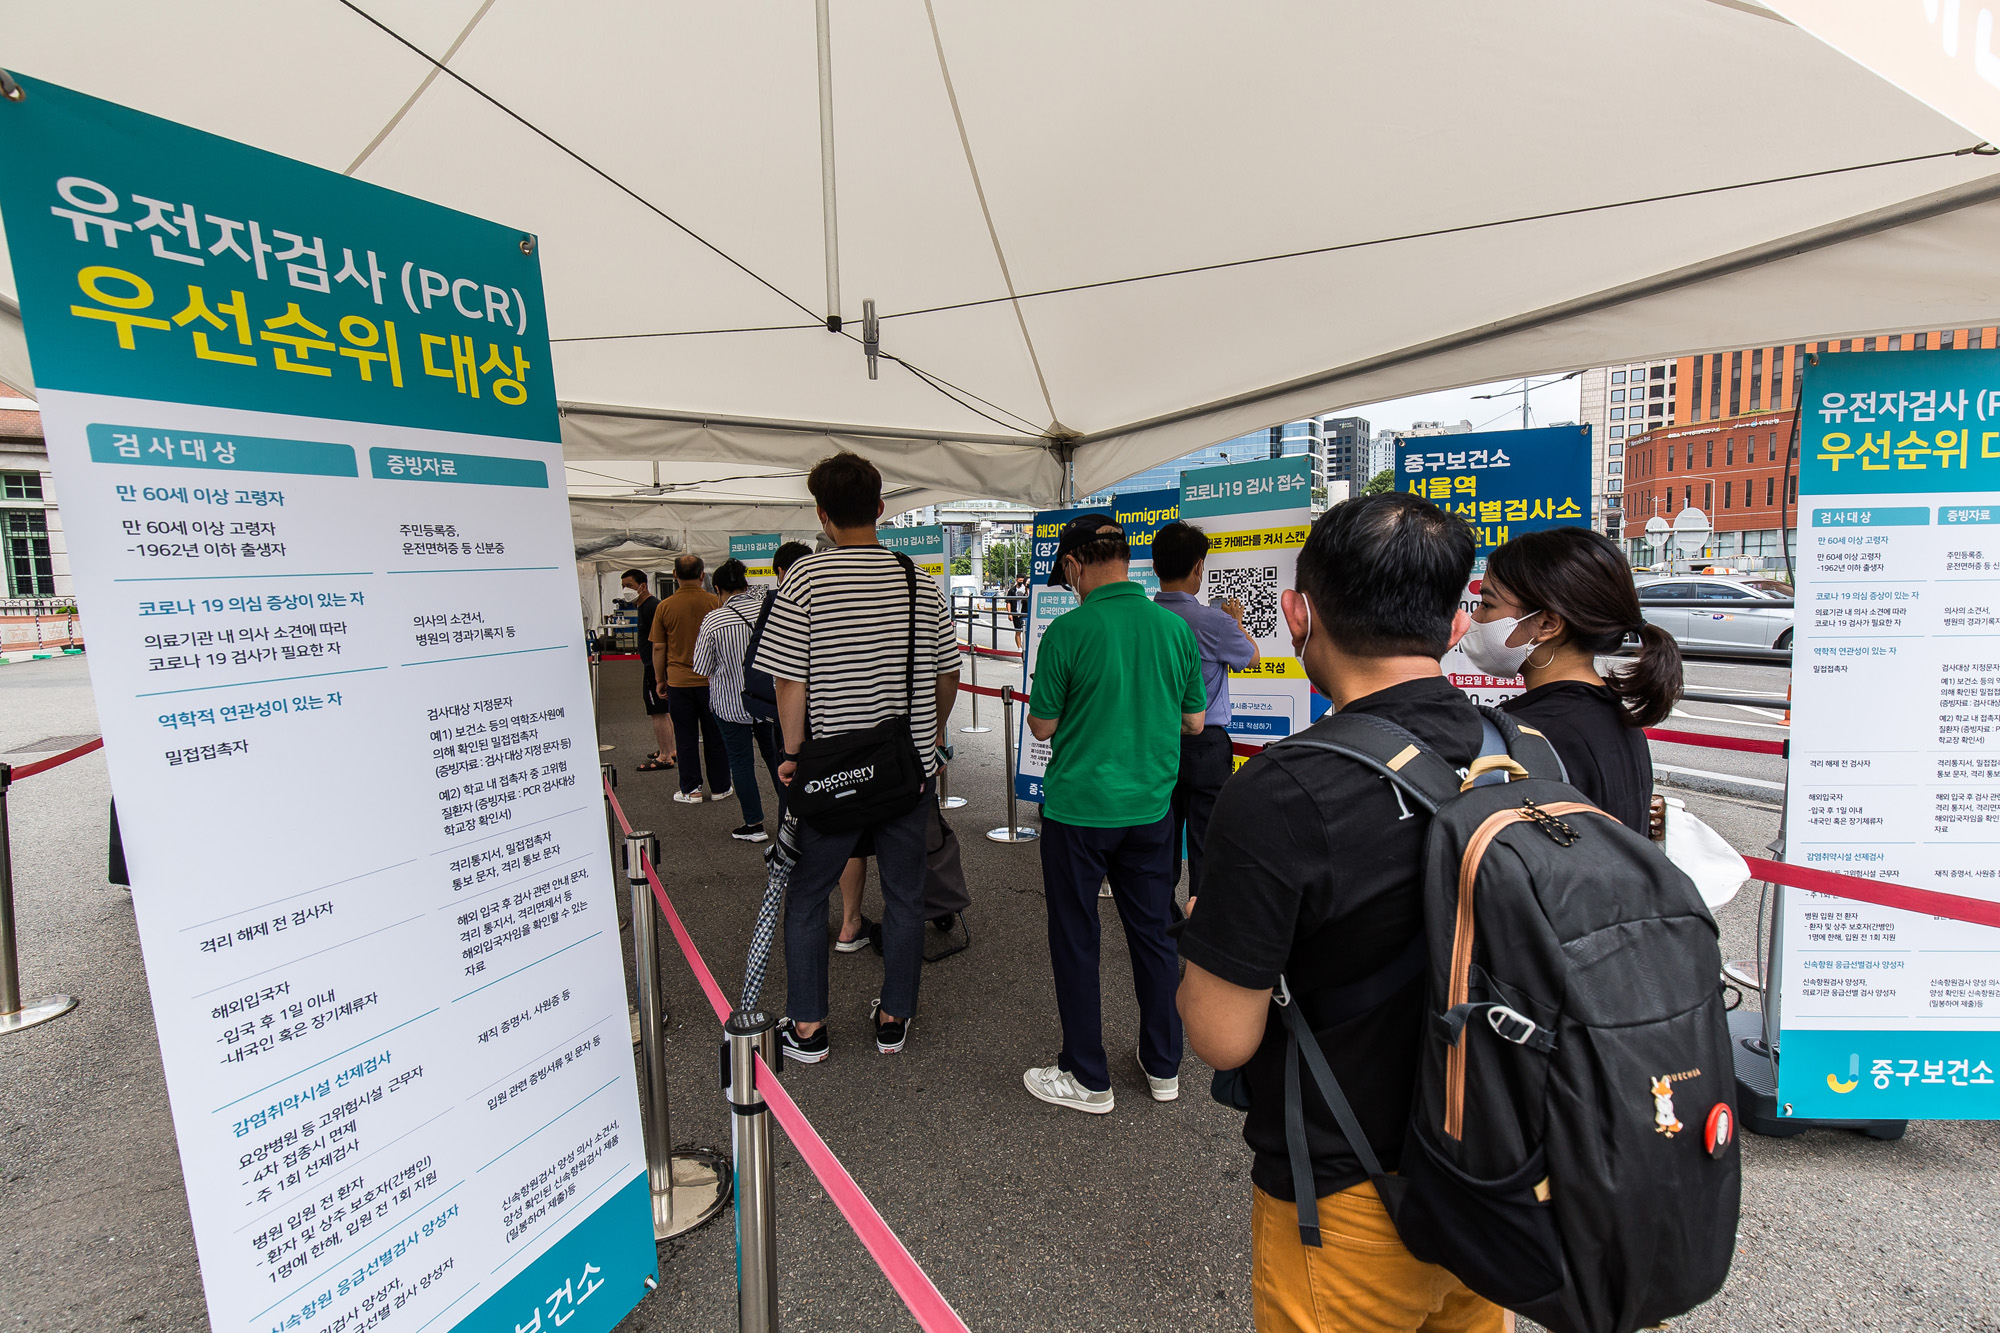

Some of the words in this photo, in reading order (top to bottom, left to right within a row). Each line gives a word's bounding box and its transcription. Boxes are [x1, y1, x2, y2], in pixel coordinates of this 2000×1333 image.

[51, 176, 387, 305] 유전자검사
[402, 262, 527, 336] (PCR)
[70, 265, 403, 388] 우선순위
[420, 333, 531, 406] 대상
[1819, 389, 1968, 423] 유전자검사
[113, 433, 236, 464] 검사대상
[1817, 429, 1968, 471] 우선순위
[387, 455, 457, 476] 증빙자료
[1404, 449, 1511, 473] 중구보건소
[116, 485, 136, 502] 만
[143, 487, 188, 503] 60세
[194, 488, 229, 505] 이상
[235, 490, 284, 506] 고령자
[1185, 481, 1242, 501] 코로나19
[1246, 477, 1273, 495] 검사
[1277, 473, 1306, 492] 접수
[1408, 475, 1477, 498] 서울역
[1115, 505, 1180, 525] Immigrati
[1821, 512, 1871, 524] 검사대상
[1947, 510, 1990, 522] 증빙자료
[123, 520, 141, 535] 만
[147, 521, 188, 535] 60세
[192, 521, 225, 536] 이상
[230, 522, 276, 536] 고령자
[400, 524, 459, 537] 주민등록증,
[127, 543, 199, 557] -1962년
[204, 543, 236, 557] 이하
[241, 542, 286, 557] 출생자
[402, 543, 459, 555] 운전면허증
[461, 543, 472, 555] 등
[475, 543, 505, 554] 신분증
[732, 544, 755, 552] 코로나19
[768, 542, 779, 550] 접수
[911, 536, 924, 545] 검사
[926, 535, 940, 544] 접수
[1224, 535, 1261, 547] 카메라를
[1264, 533, 1283, 545] 켜서
[1818, 537, 1825, 545] 만
[1828, 536, 1846, 545] 60세
[1848, 536, 1863, 545] 이상
[1865, 536, 1888, 544] 고령자
[1863, 564, 1884, 572] 출생자
[139, 599, 195, 616] 코로나
[202, 600, 223, 612] 19
[229, 596, 262, 612] 의심
[267, 594, 313, 610] 증상이
[317, 592, 347, 608] 있는
[350, 592, 365, 606] 자
[1816, 592, 1838, 600] 코로나
[1853, 592, 1868, 600] 의심
[1870, 592, 1892, 600] 증상이
[1894, 591, 1909, 599] 있는
[1911, 591, 1919, 599] 자
[414, 614, 447, 627] 의사의
[450, 612, 485, 624] 소견서,
[144, 632, 213, 649] 의료기관
[218, 629, 234, 644] 내
[239, 627, 269, 642] 의사
[274, 624, 317, 639] 소견에
[320, 621, 347, 635] 따라
[416, 632, 449, 646] 병원의
[453, 627, 503, 642] 경과기록지
[506, 626, 516, 637] 등
[149, 654, 201, 671] 코로나
[206, 653, 227, 665] 19
[231, 647, 278, 664] 검사가
[281, 643, 324, 659] 필요한
[327, 642, 341, 654] 자
[1839, 647, 1869, 655] 연관성이
[1872, 647, 1887, 655] 있는
[1889, 647, 1897, 655] 자
[1265, 662, 1285, 673] 작성
[1813, 665, 1848, 673] 밀접접촉자
[1456, 676, 1482, 685] 일요일
[1485, 675, 1493, 685] 및
[158, 709, 215, 729] 역학적
[220, 699, 288, 721] 연관성이
[293, 695, 323, 711] 있는
[327, 692, 343, 706] 자
[427, 703, 470, 721] 검사대상
[473, 696, 513, 713] 지정문자
[430, 729, 453, 742] 예1)
[455, 723, 487, 738] 보건소
[489, 718, 508, 731] 등의
[511, 707, 565, 727] 역학조사원에
[165, 739, 249, 766] 밀접접촉자
[433, 745, 455, 759] 의해
[458, 739, 488, 754] 확인된
[491, 729, 538, 748] 밀접접촉자
[826, 776, 869, 793] EXPEDITION
[1807, 853, 1851, 861] 감염취약시설
[1854, 853, 1884, 861] 선제검사
[200, 933, 232, 953] 격리
[237, 922, 269, 941] 해제
[272, 916, 287, 931] 전
[291, 901, 334, 926] 검사자
[465, 961, 486, 976] 자료
[1803, 961, 1833, 969] 신속항원
[1835, 961, 1880, 969] 응급선별검사
[1882, 961, 1904, 969] 양성자
[211, 981, 290, 1020] 해외입국자
[216, 1022, 255, 1045] -입국
[260, 1014, 275, 1029] 후
[280, 1002, 304, 1021] 1일
[306, 989, 336, 1009] 이내
[478, 1026, 499, 1044] 재직
[500, 1011, 532, 1034] 증명서,
[534, 994, 560, 1015] 사원증
[562, 989, 571, 1001] 등
[1870, 1059, 1995, 1089] 중구보건소
[232, 1080, 331, 1138] 감염취약시설
[335, 1050, 391, 1087] 선제검사
[239, 1129, 298, 1170] 요양병원
[301, 1121, 316, 1137] 등
[318, 1086, 383, 1128] 고위험시설
[388, 1065, 423, 1092] 근무자
[253, 1224, 283, 1250] 병원
[287, 1204, 316, 1230] 입원
[320, 1194, 334, 1210] 전
[337, 1176, 364, 1200] 환자
